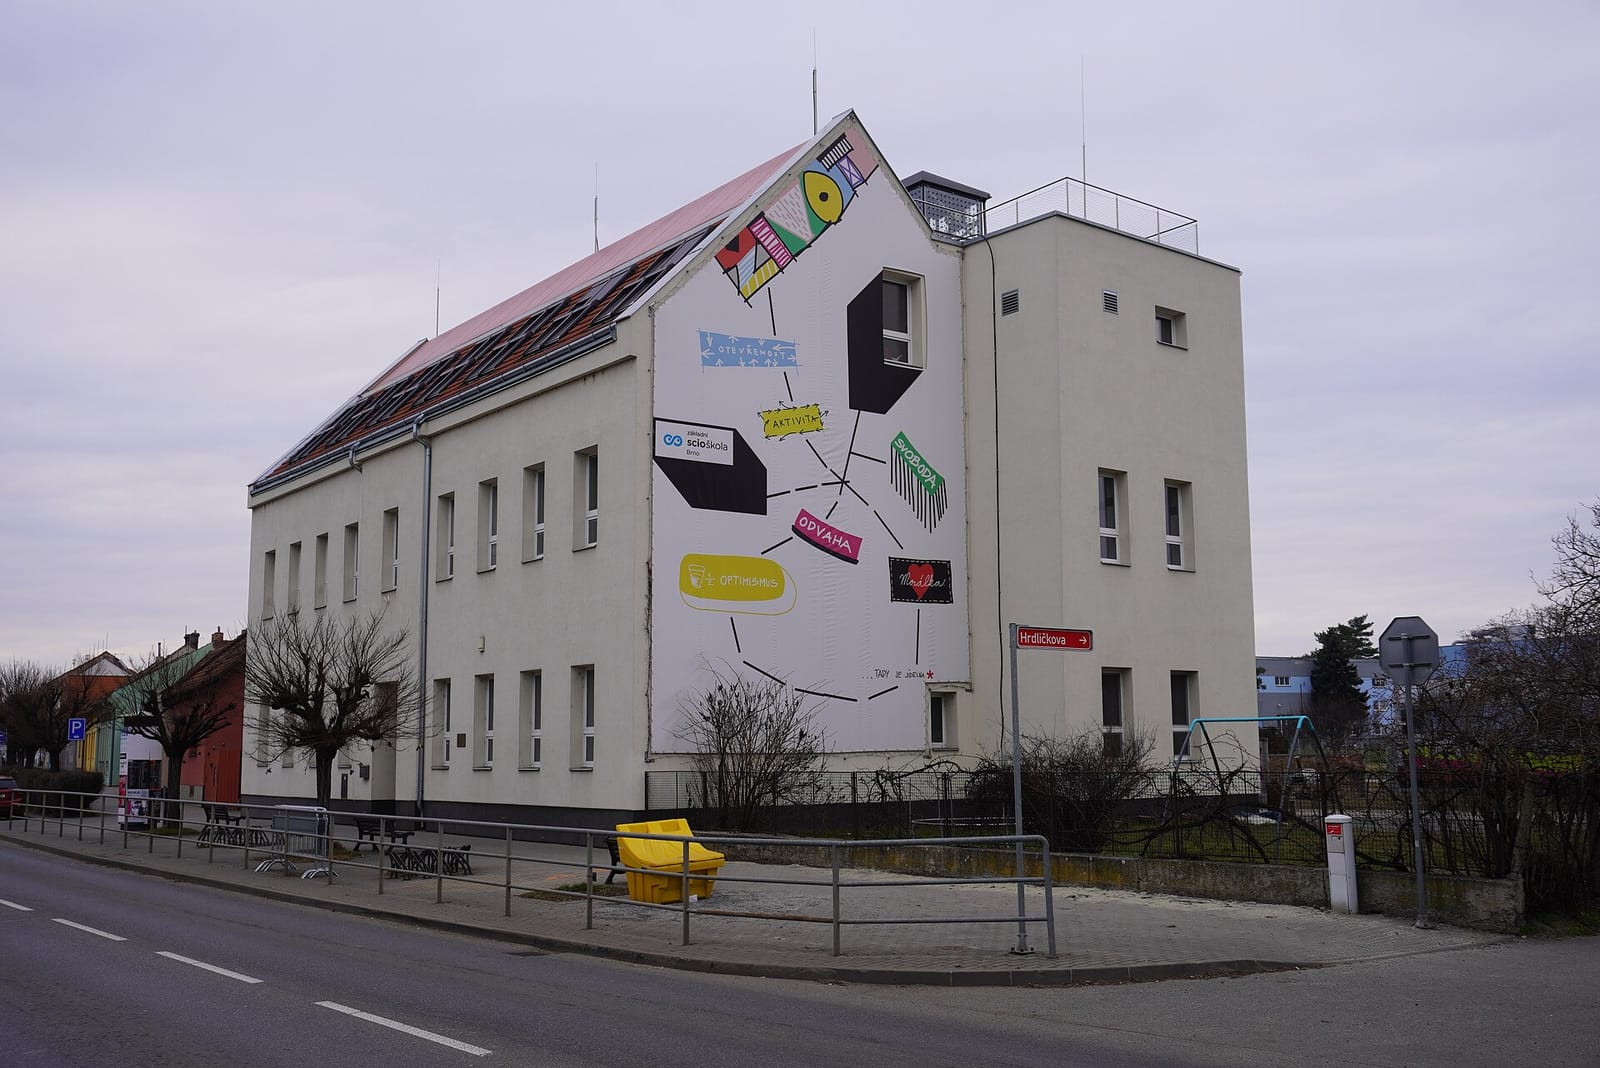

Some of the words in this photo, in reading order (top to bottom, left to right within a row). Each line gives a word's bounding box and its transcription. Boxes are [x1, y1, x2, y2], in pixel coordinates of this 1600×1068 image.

[718, 345, 786, 359] OTEVŘENOST
[773, 415, 818, 429] AKTIVITA
[687, 438, 728, 451] scioškola
[895, 438, 936, 489] SVOBODA
[799, 516, 852, 554] ODVAHA
[720, 575, 778, 588] OPTIMISMUS
[1020, 631, 1066, 645] Hrdličkova
[72, 721, 82, 734] P
